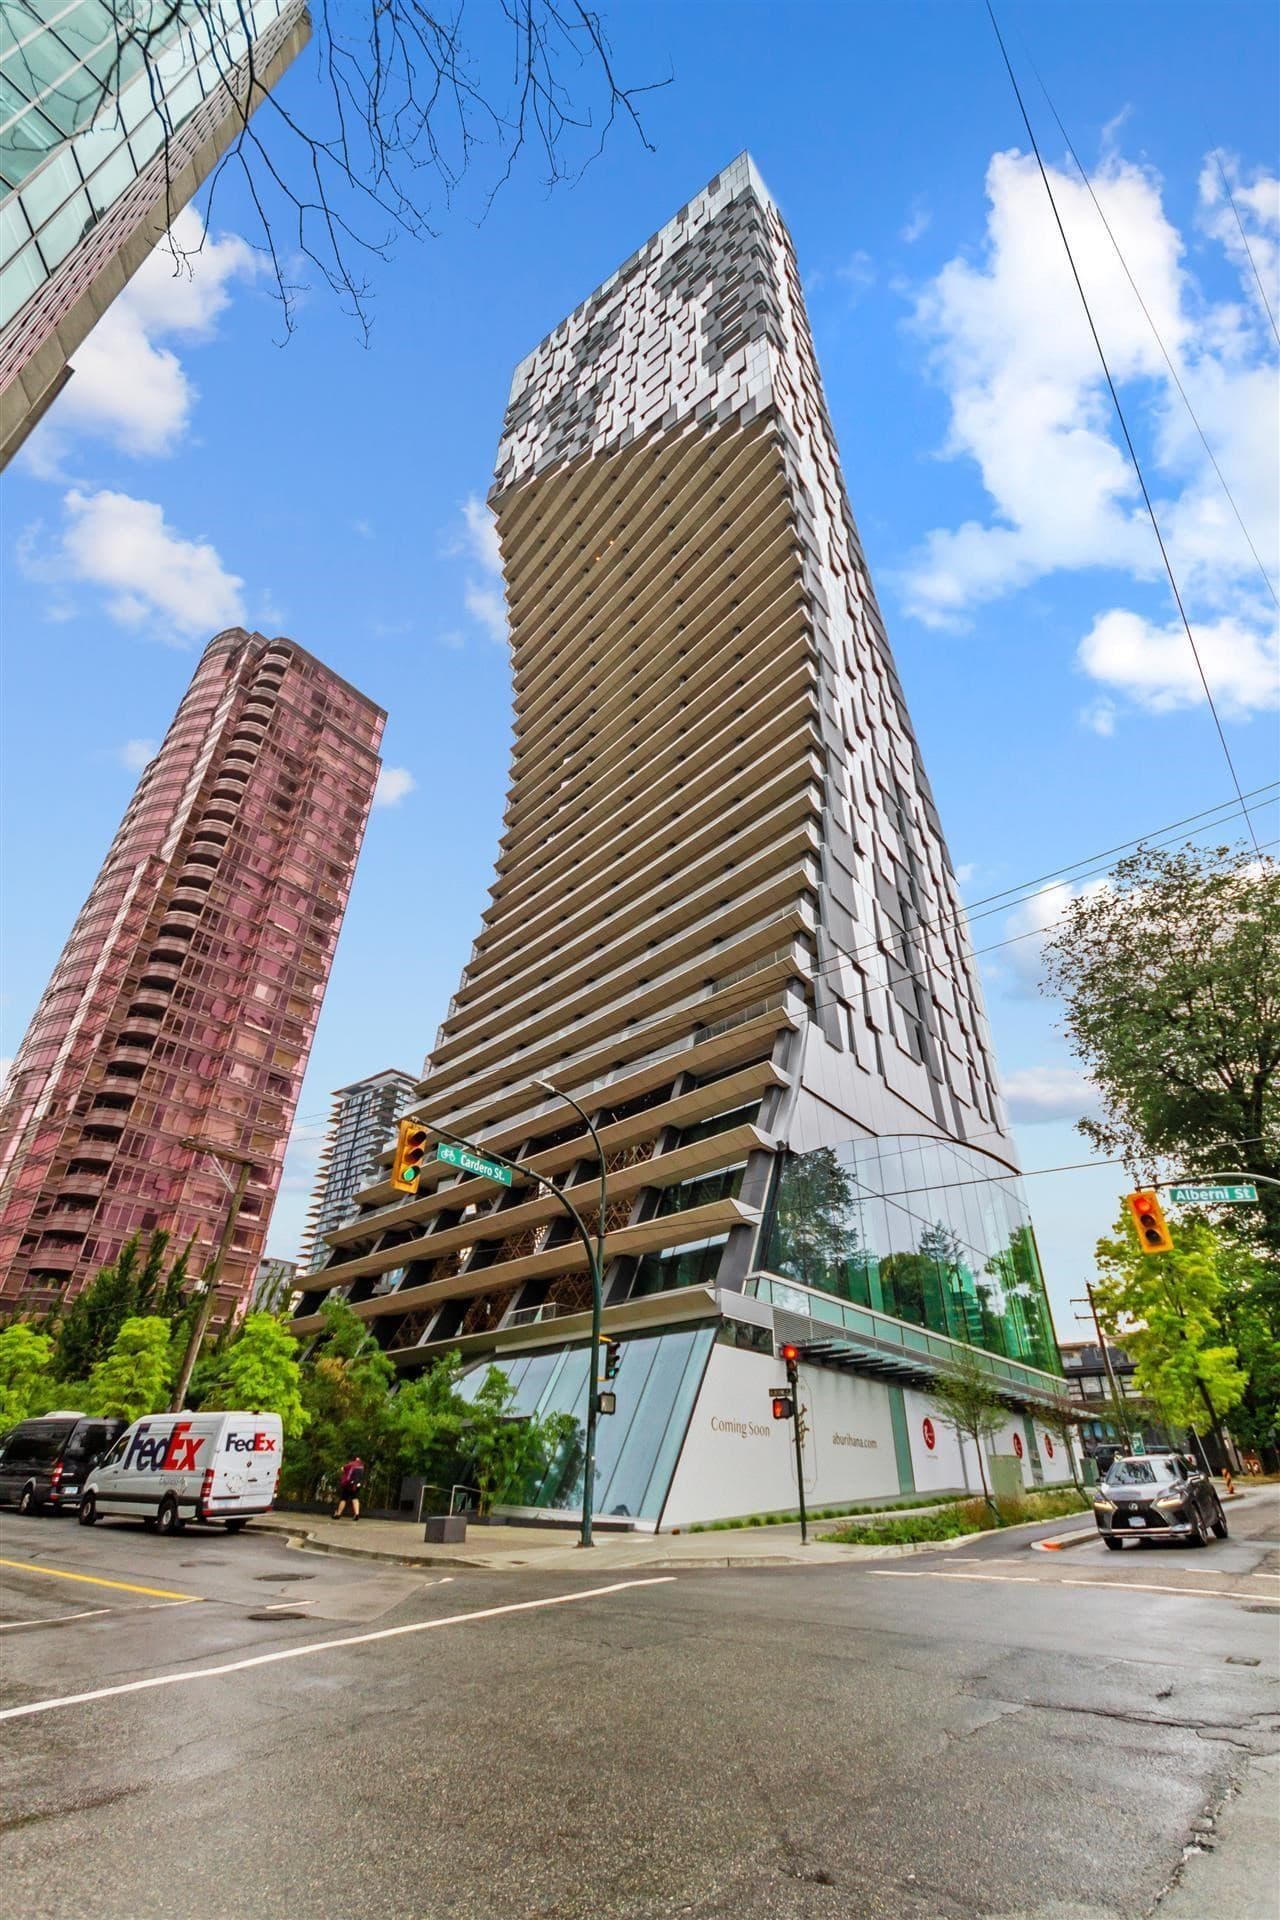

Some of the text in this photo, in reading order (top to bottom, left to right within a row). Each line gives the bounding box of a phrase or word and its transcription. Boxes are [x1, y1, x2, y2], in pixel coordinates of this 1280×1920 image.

[460, 1155, 505, 1180] Cardero St.
[1176, 1188, 1251, 1200] Alberni St
[711, 1416, 747, 1438] Coming
[748, 1421, 770, 1437] Soon
[123, 1421, 205, 1471] FedEx
[225, 1432, 275, 1452] FedEx
[832, 1432, 877, 1448] aburihana.com
